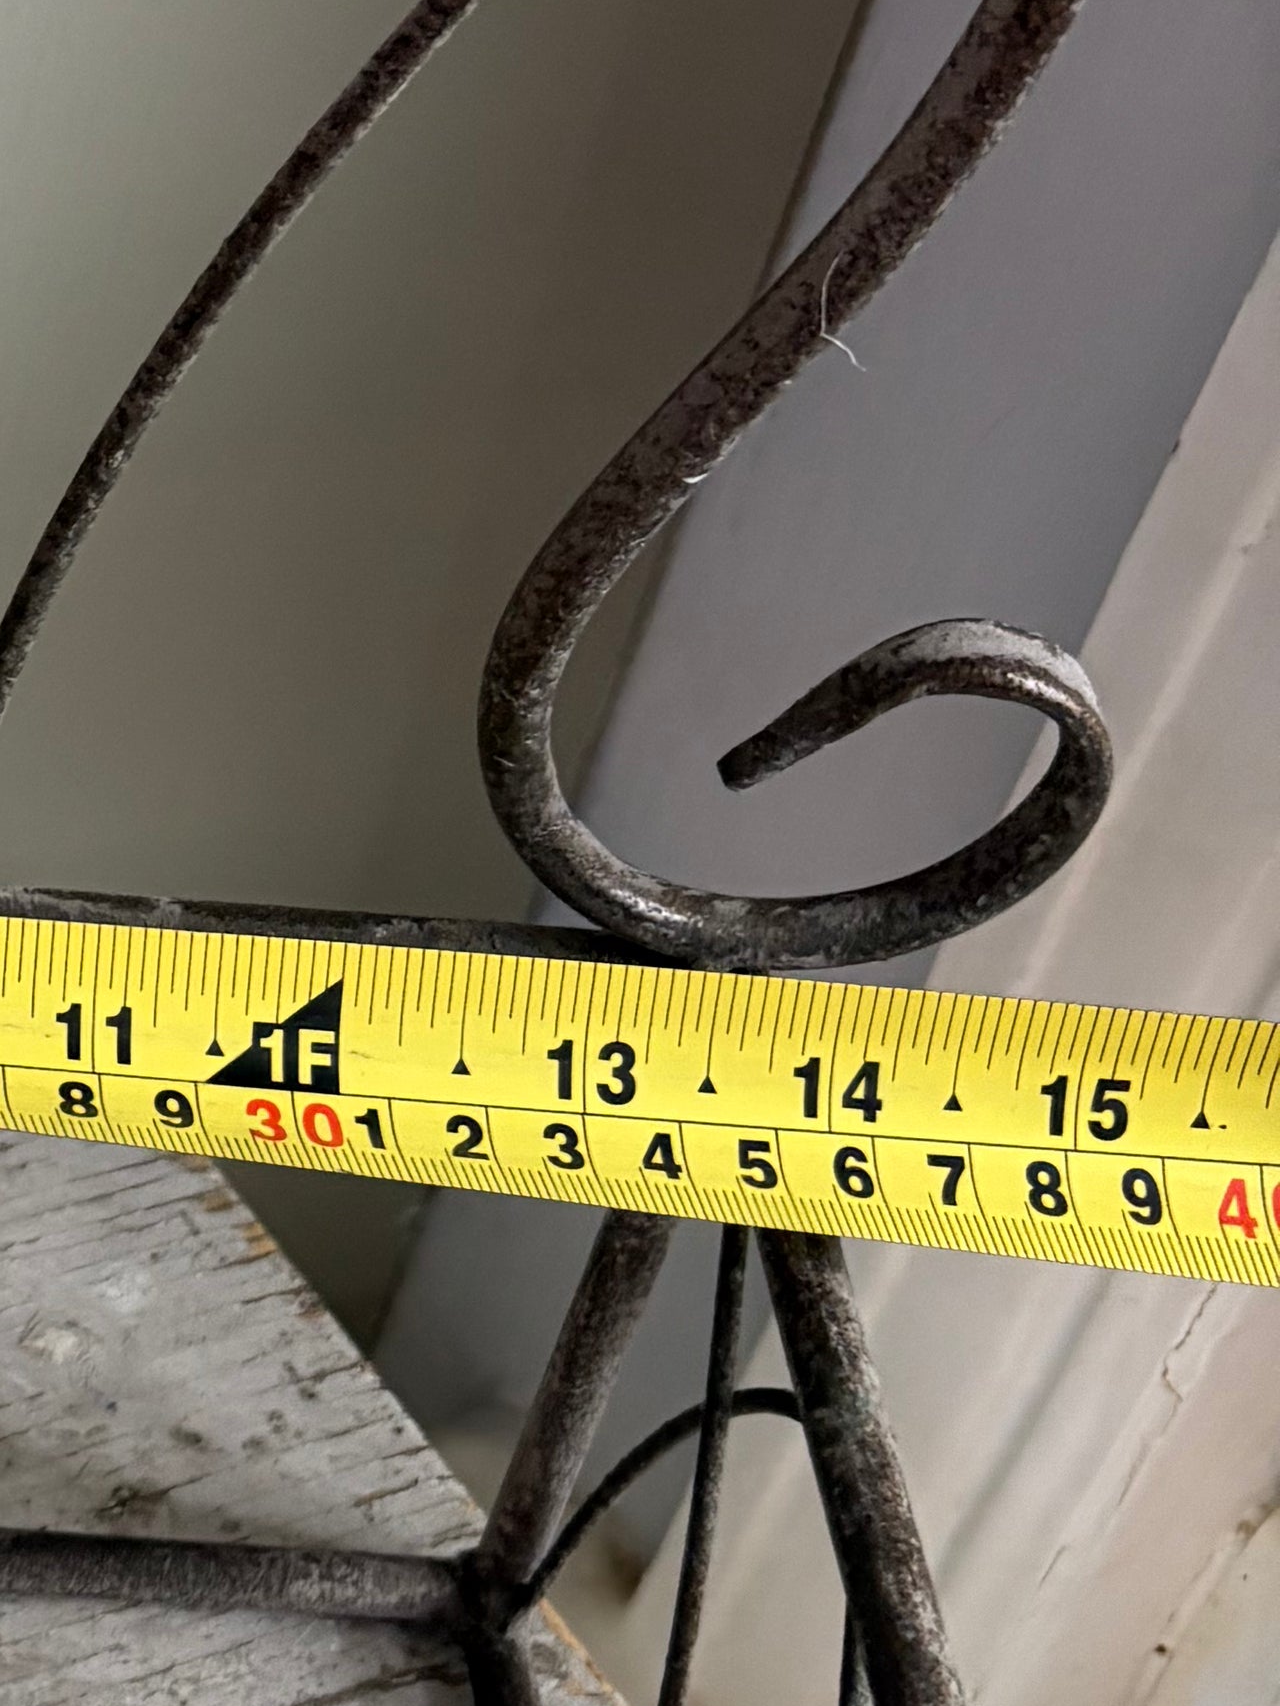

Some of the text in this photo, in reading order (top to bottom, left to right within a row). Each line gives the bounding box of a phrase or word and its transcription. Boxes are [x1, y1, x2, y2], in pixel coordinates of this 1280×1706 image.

[56, 1003, 132, 1065] 11
[259, 1028, 336, 1085] 1F
[547, 1039, 636, 1106] 13
[793, 1057, 882, 1123] 14
[1040, 1075, 1132, 1141] 15
[58, 1081, 99, 1118] 8
[154, 1089, 195, 1129] 9
[245, 1098, 344, 1148] 30
[354, 1108, 386, 1150] 1
[445, 1114, 490, 1161] 2
[543, 1123, 585, 1170] 3
[642, 1132, 682, 1179] 4
[738, 1139, 778, 1189] 5
[833, 1146, 875, 1199] 6
[926, 1154, 965, 1206] 7
[1025, 1160, 1068, 1217] 8
[1121, 1167, 1162, 1226] 9
[1218, 1178, 1280, 1239] 4
